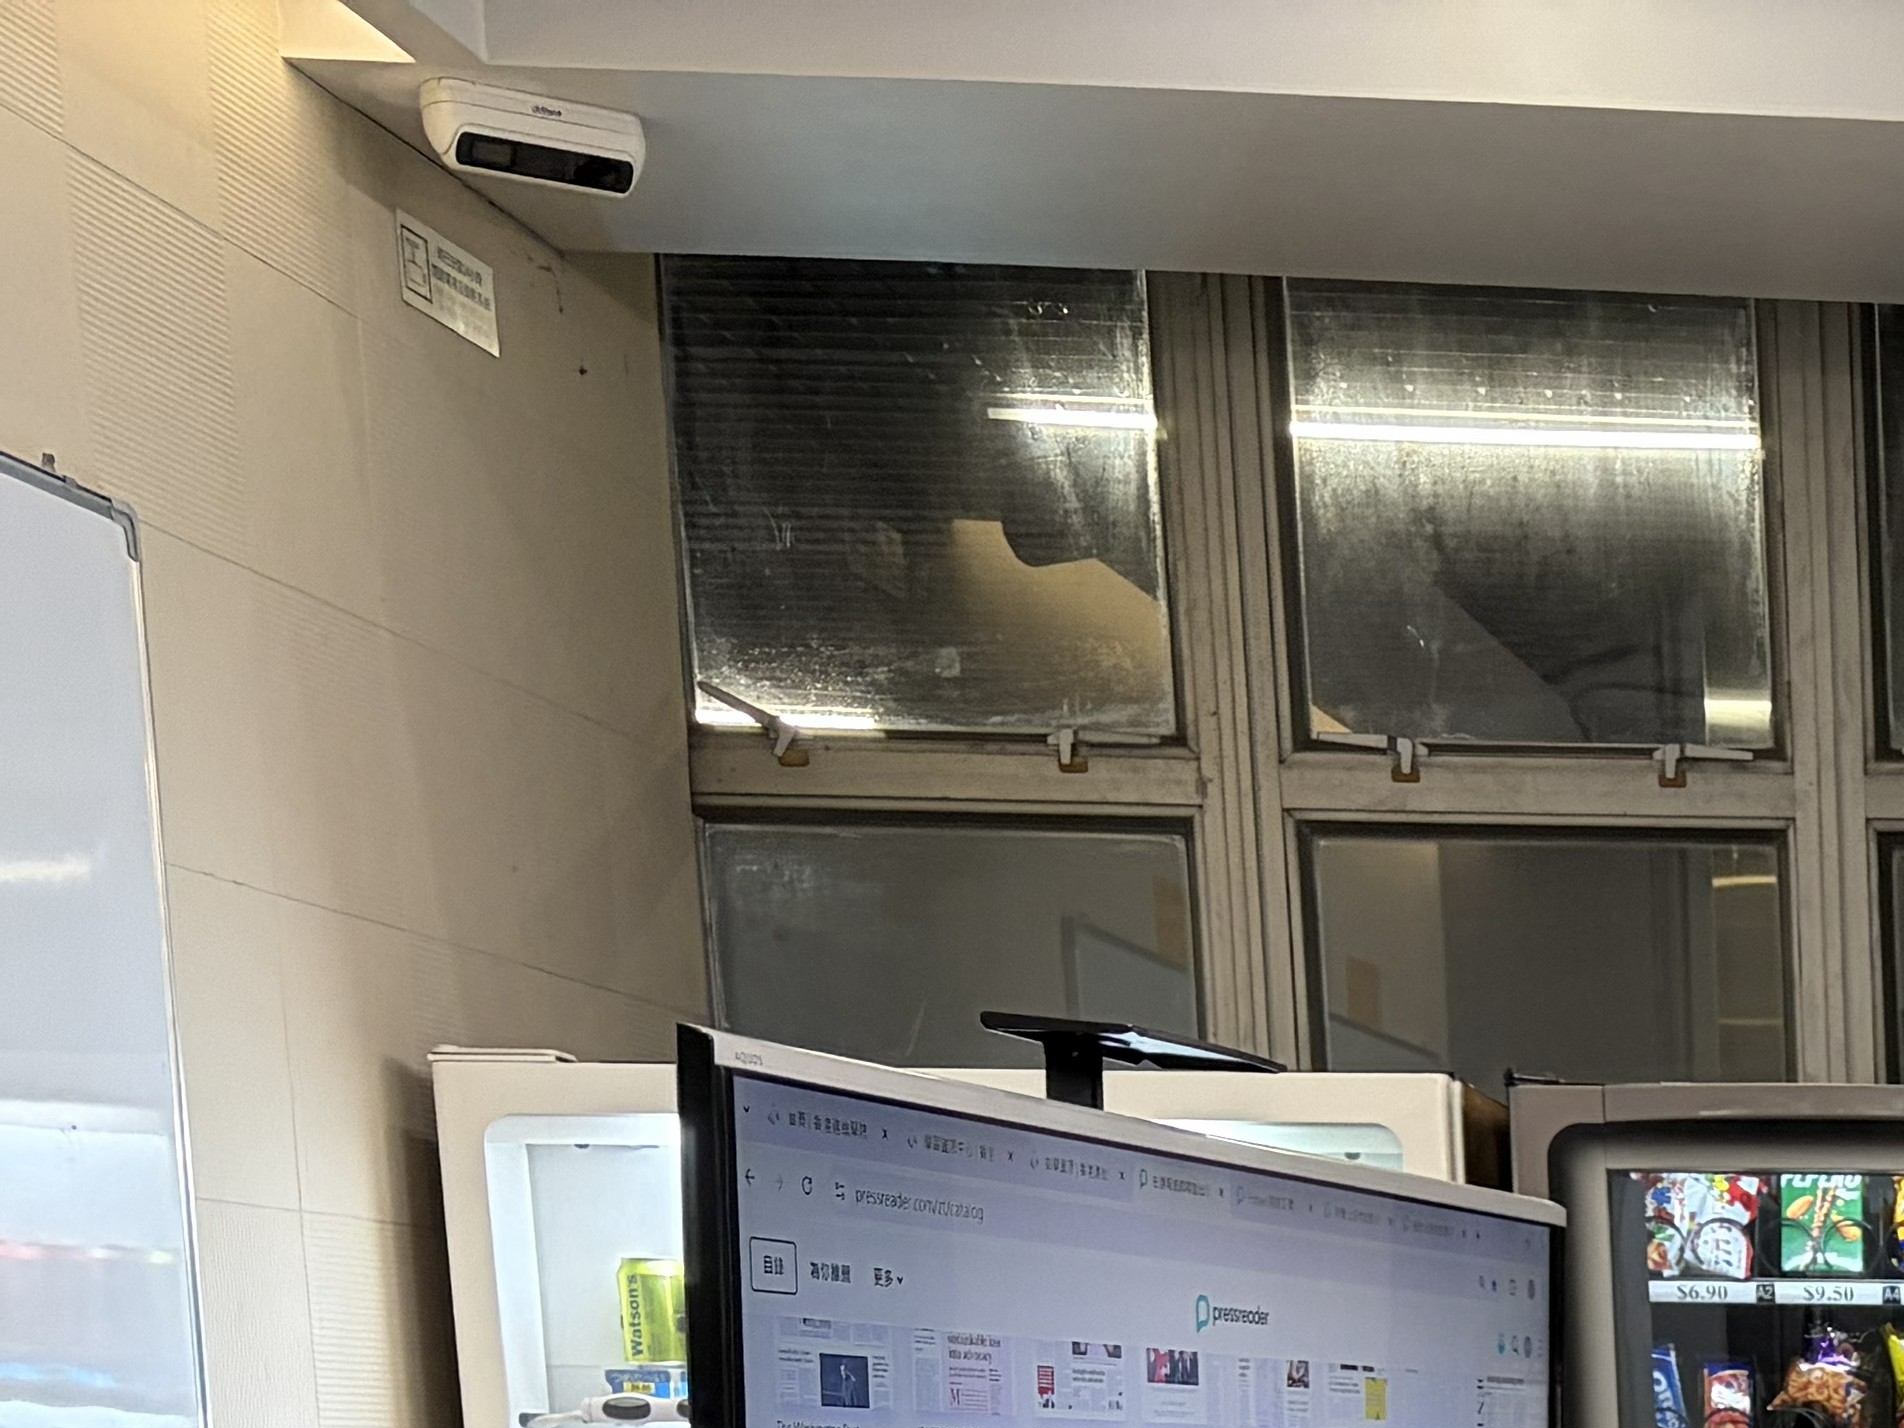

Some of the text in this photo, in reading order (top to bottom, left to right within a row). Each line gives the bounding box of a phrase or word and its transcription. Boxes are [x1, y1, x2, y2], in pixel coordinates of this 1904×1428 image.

[1677, 1286, 1727, 1300] $6.90
[1757, 1284, 1774, 1298] A2
[1804, 1286, 1853, 1301] $9.50
[1212, 1304, 1269, 1326] pressreader
